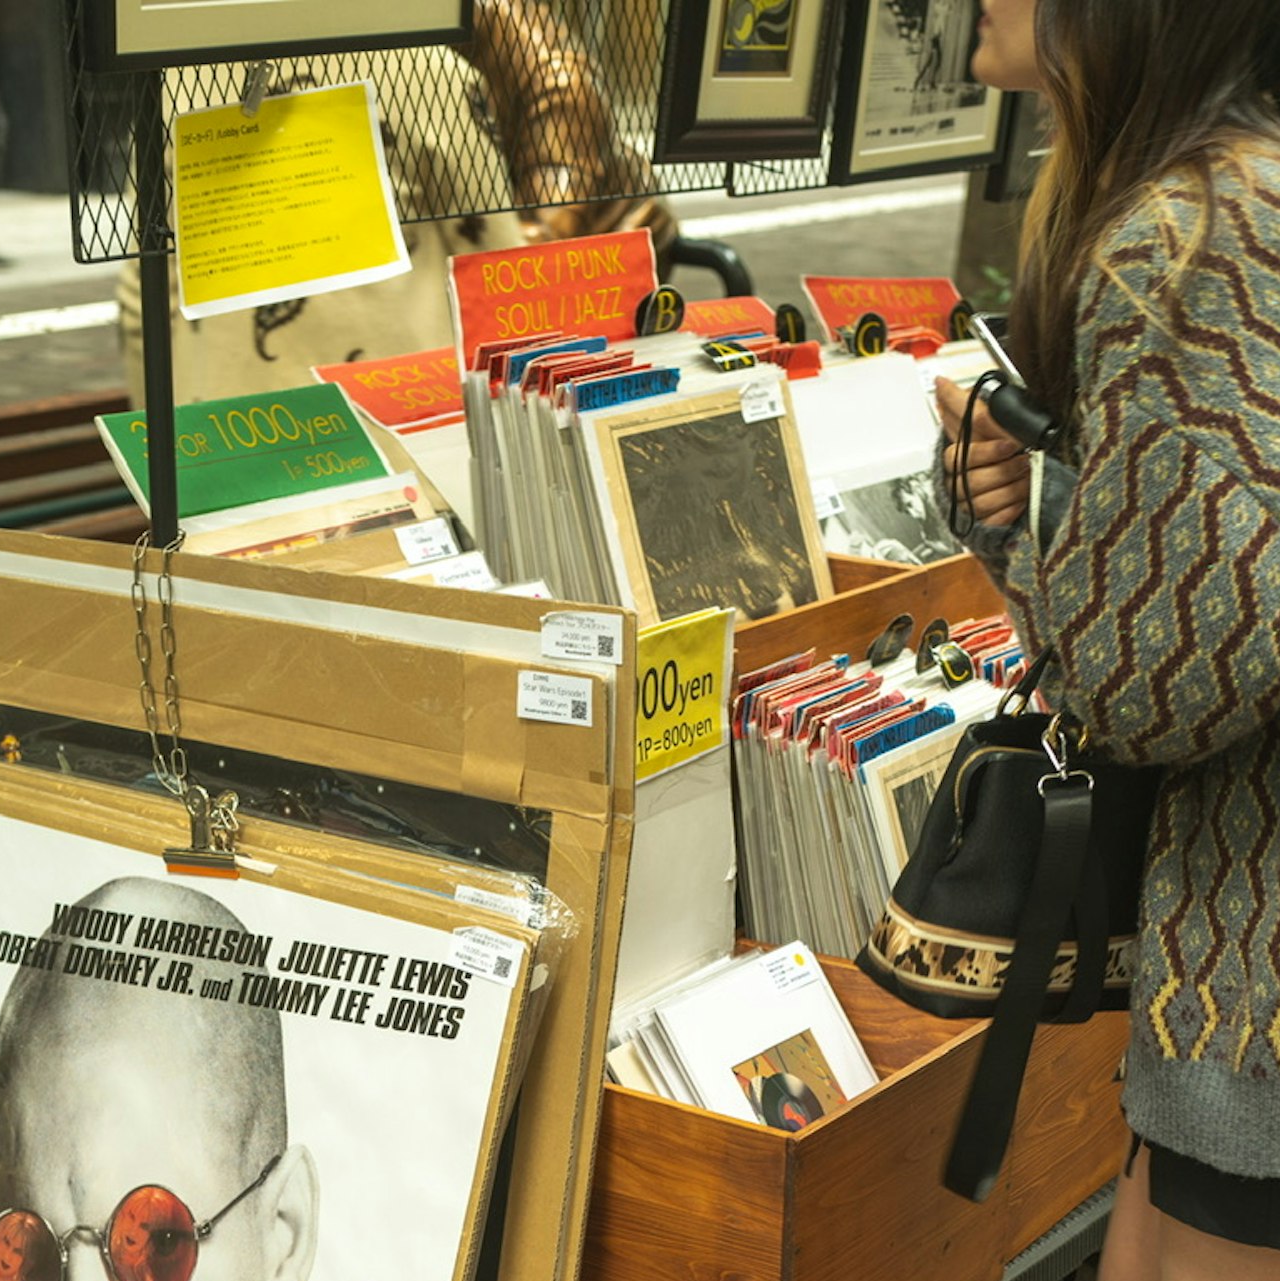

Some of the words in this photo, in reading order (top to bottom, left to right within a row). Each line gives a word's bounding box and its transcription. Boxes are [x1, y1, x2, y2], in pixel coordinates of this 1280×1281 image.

[241, 123, 260, 137] Card
[482, 256, 550, 296] ROCK
[568, 244, 627, 281] PUNK
[494, 302, 554, 338] SOUL
[572, 286, 625, 325] JAZZ
[654, 290, 677, 333] B
[827, 284, 879, 308] ROCK
[857, 321, 880, 357] G
[353, 364, 436, 390] ROCK
[388, 384, 461, 410] SOUL
[208, 403, 348, 452] 1000yen
[305, 451, 371, 478] 500yen
[523, 682, 538, 692] Star
[539, 684, 556, 695] Wars
[635, 660, 713, 720] 00yen
[638, 717, 713, 762] 1P=800yen
[51, 903, 134, 945] WOODY
[133, 916, 273, 968] HARRELSON
[277, 940, 389, 987] JULIETTE
[390, 957, 472, 1001] LEWIS
[62, 944, 160, 988] DOWNEY
[156, 960, 195, 996] JR.
[199, 978, 234, 1002] und
[238, 972, 330, 1017] TOMMY
[329, 987, 374, 1025] LEE
[374, 996, 466, 1040] JONES
